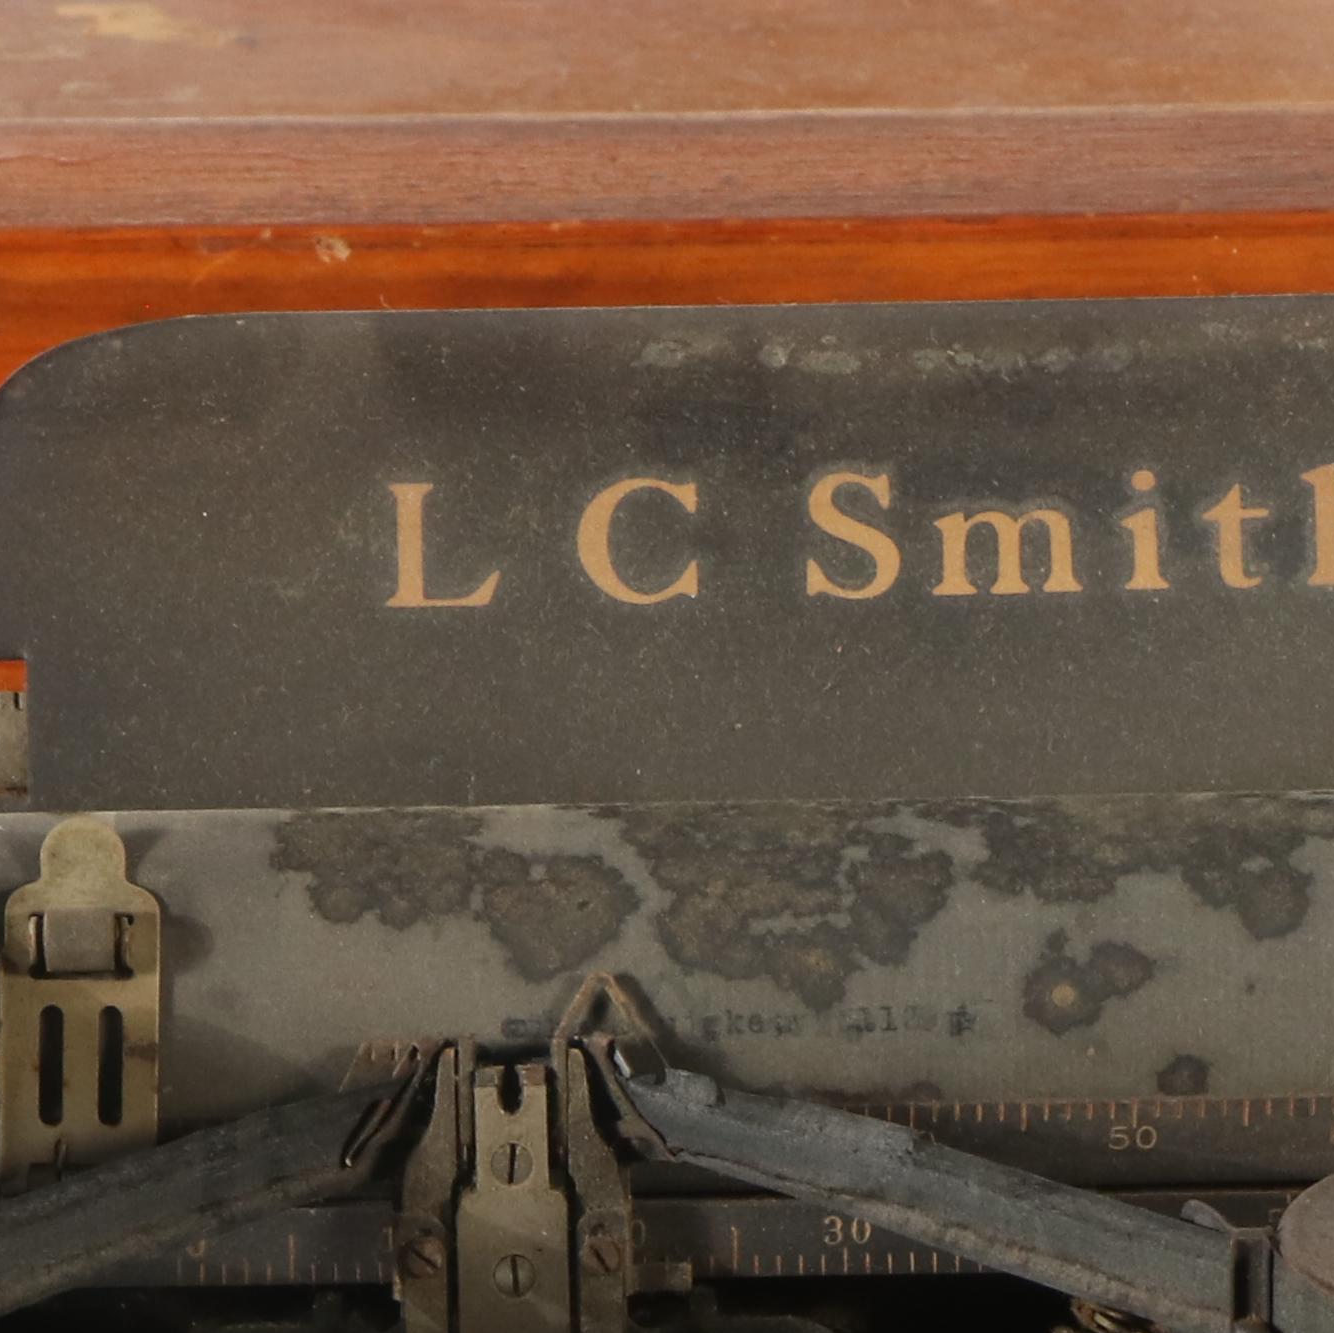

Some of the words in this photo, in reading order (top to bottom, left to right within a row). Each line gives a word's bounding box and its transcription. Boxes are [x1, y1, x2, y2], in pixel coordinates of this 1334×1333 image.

[387, 482, 500, 607] L
[577, 477, 699, 604] C
[1108, 1127, 1158, 1150] 50
[824, 1216, 872, 1244] 30
